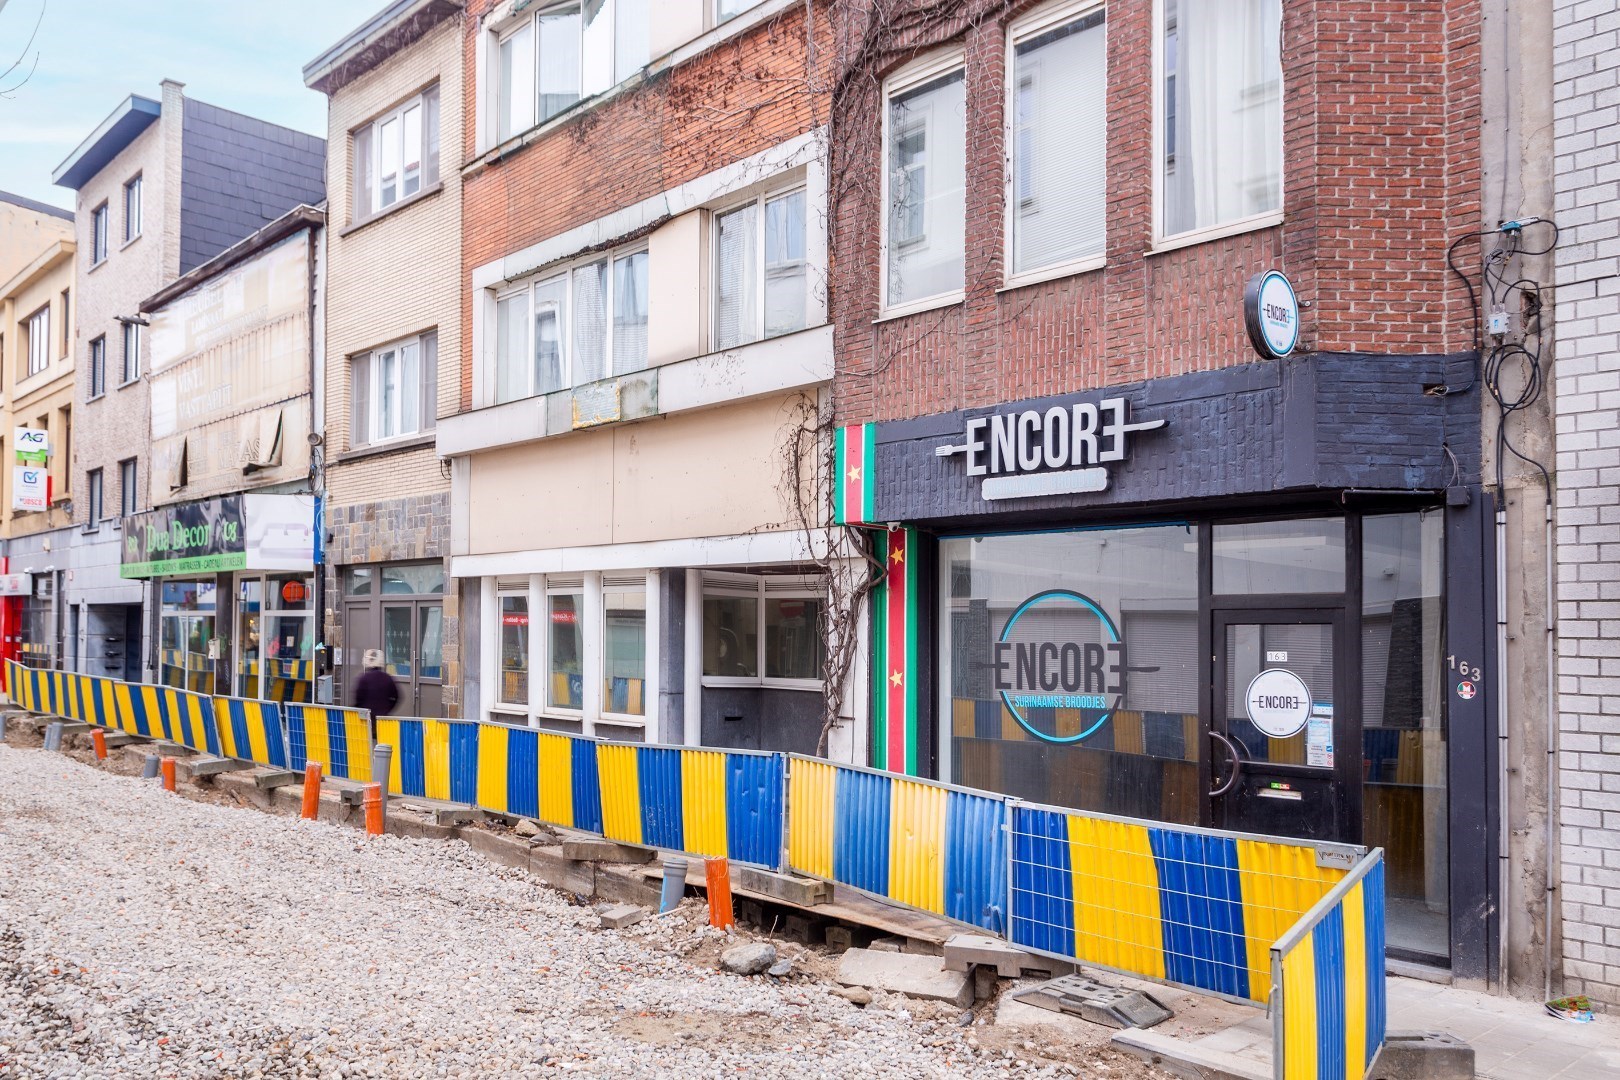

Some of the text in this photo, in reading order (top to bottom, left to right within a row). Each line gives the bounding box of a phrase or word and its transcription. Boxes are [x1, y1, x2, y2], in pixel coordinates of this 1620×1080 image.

[1267, 303, 1290, 324] ENCORE
[20, 432, 44, 443] AG
[967, 397, 1125, 477] ENCORE
[146, 520, 212, 553] Dua Decor
[1268, 652, 1286, 661] 163
[995, 642, 1127, 694] ENCORE
[1446, 655, 1480, 682] 163
[1014, 695, 1106, 709] SURINAAMSE BROODJES
[1258, 695, 1299, 710] ENCORE
